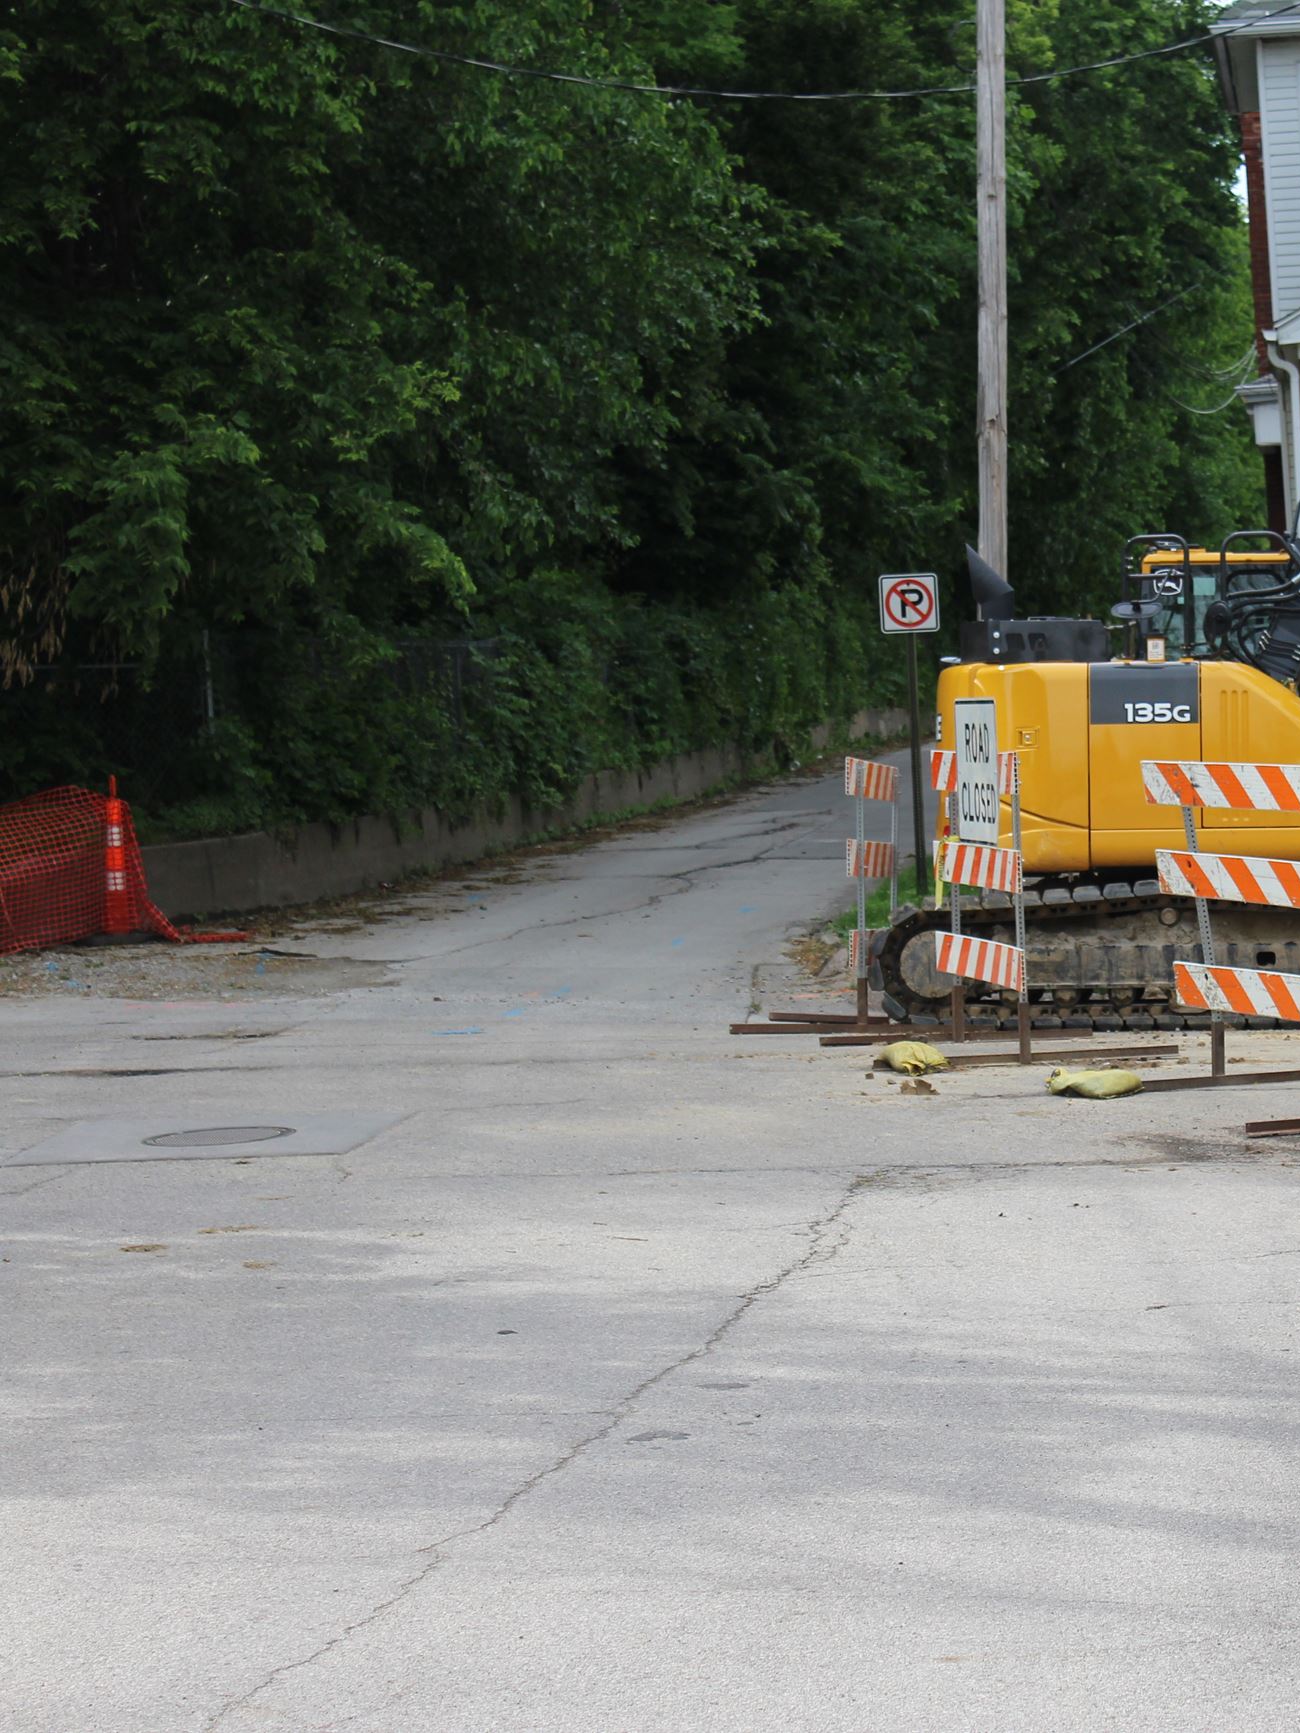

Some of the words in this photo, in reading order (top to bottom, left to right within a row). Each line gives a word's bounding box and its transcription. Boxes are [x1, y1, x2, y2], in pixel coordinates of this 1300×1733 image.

[1124, 703, 1191, 722] 135G
[964, 723, 990, 763] ROAD
[961, 782, 996, 824] CLOSED
